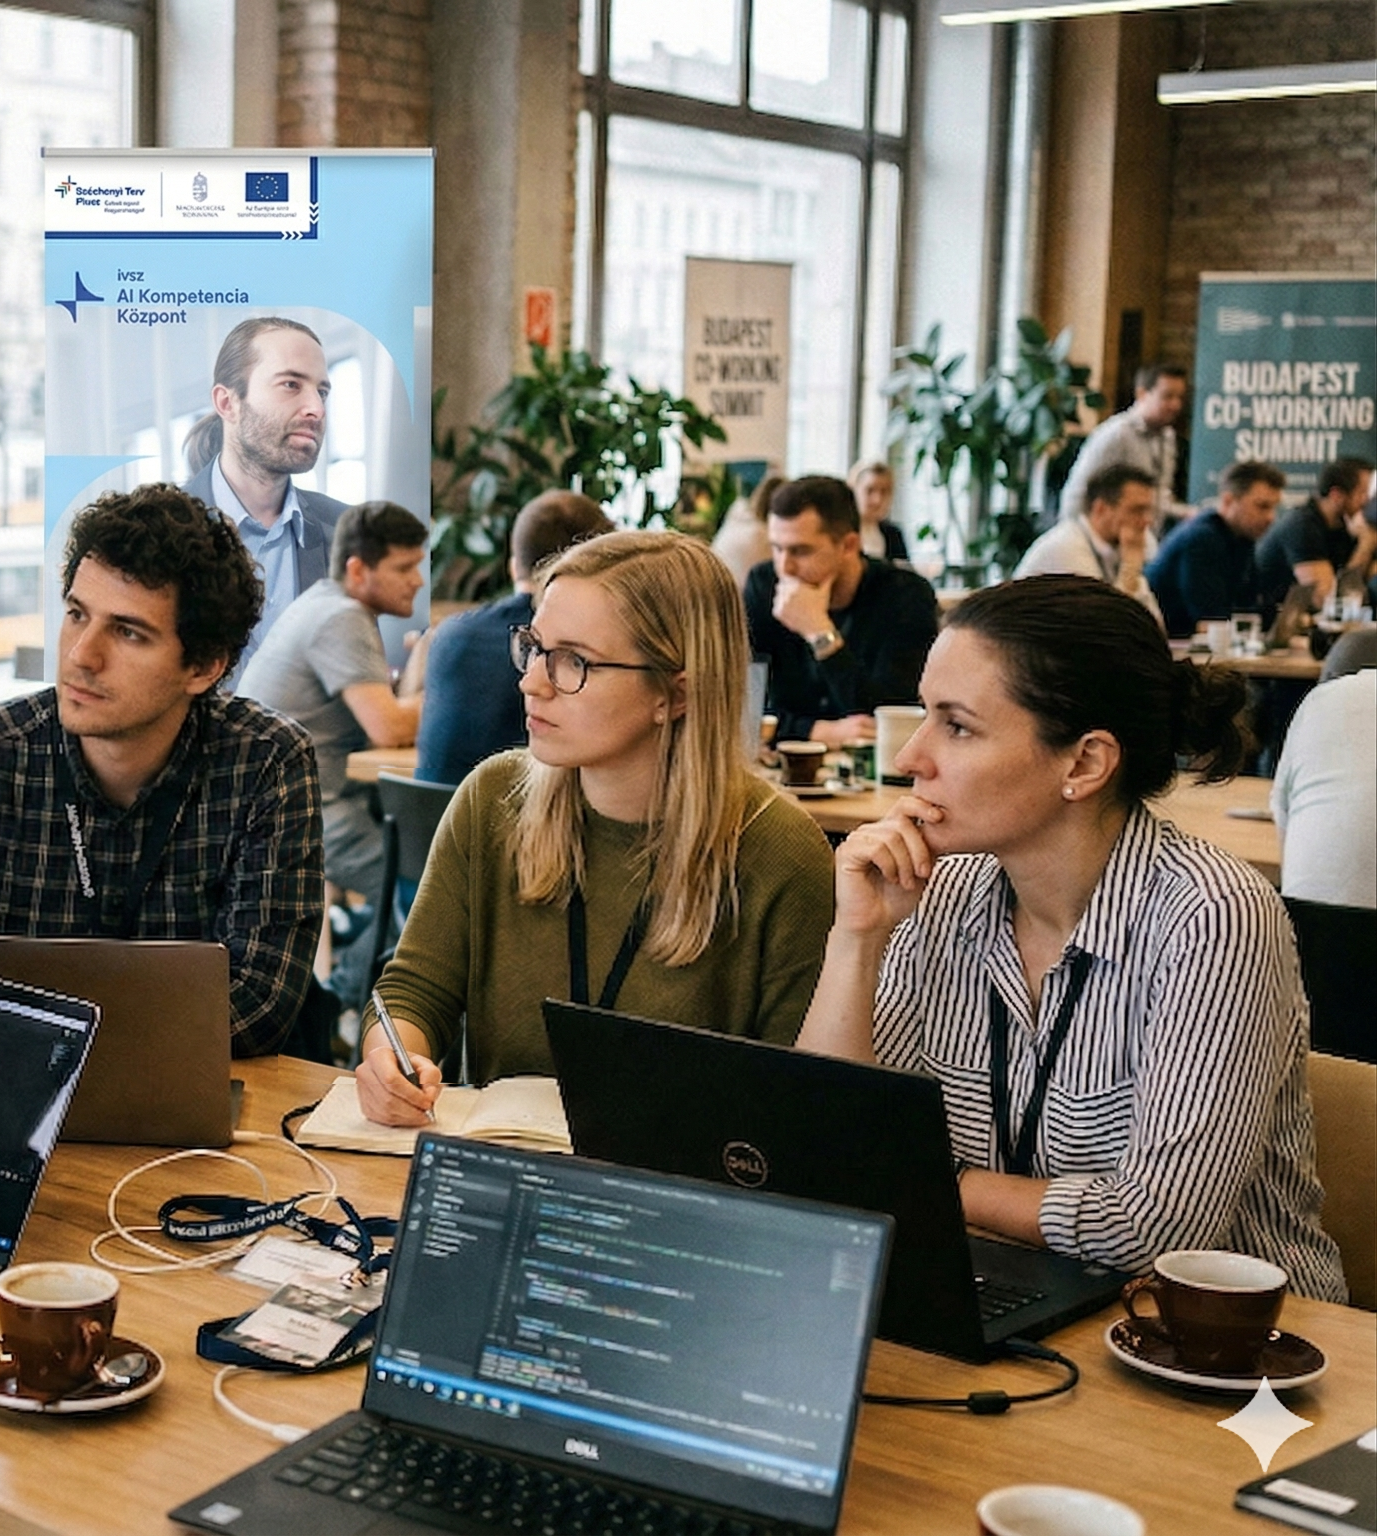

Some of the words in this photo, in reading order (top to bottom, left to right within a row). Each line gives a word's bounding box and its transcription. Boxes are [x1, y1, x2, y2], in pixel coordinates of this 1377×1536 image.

[117, 268, 145, 282] ivsz
[117, 288, 134, 303] AI
[138, 287, 250, 307] Kompetencia
[117, 308, 187, 327] Központ
[1224, 360, 1361, 396] BUDAPEST
[1204, 394, 1375, 431] CO-WORKING
[1235, 428, 1343, 464] SUMMIT
